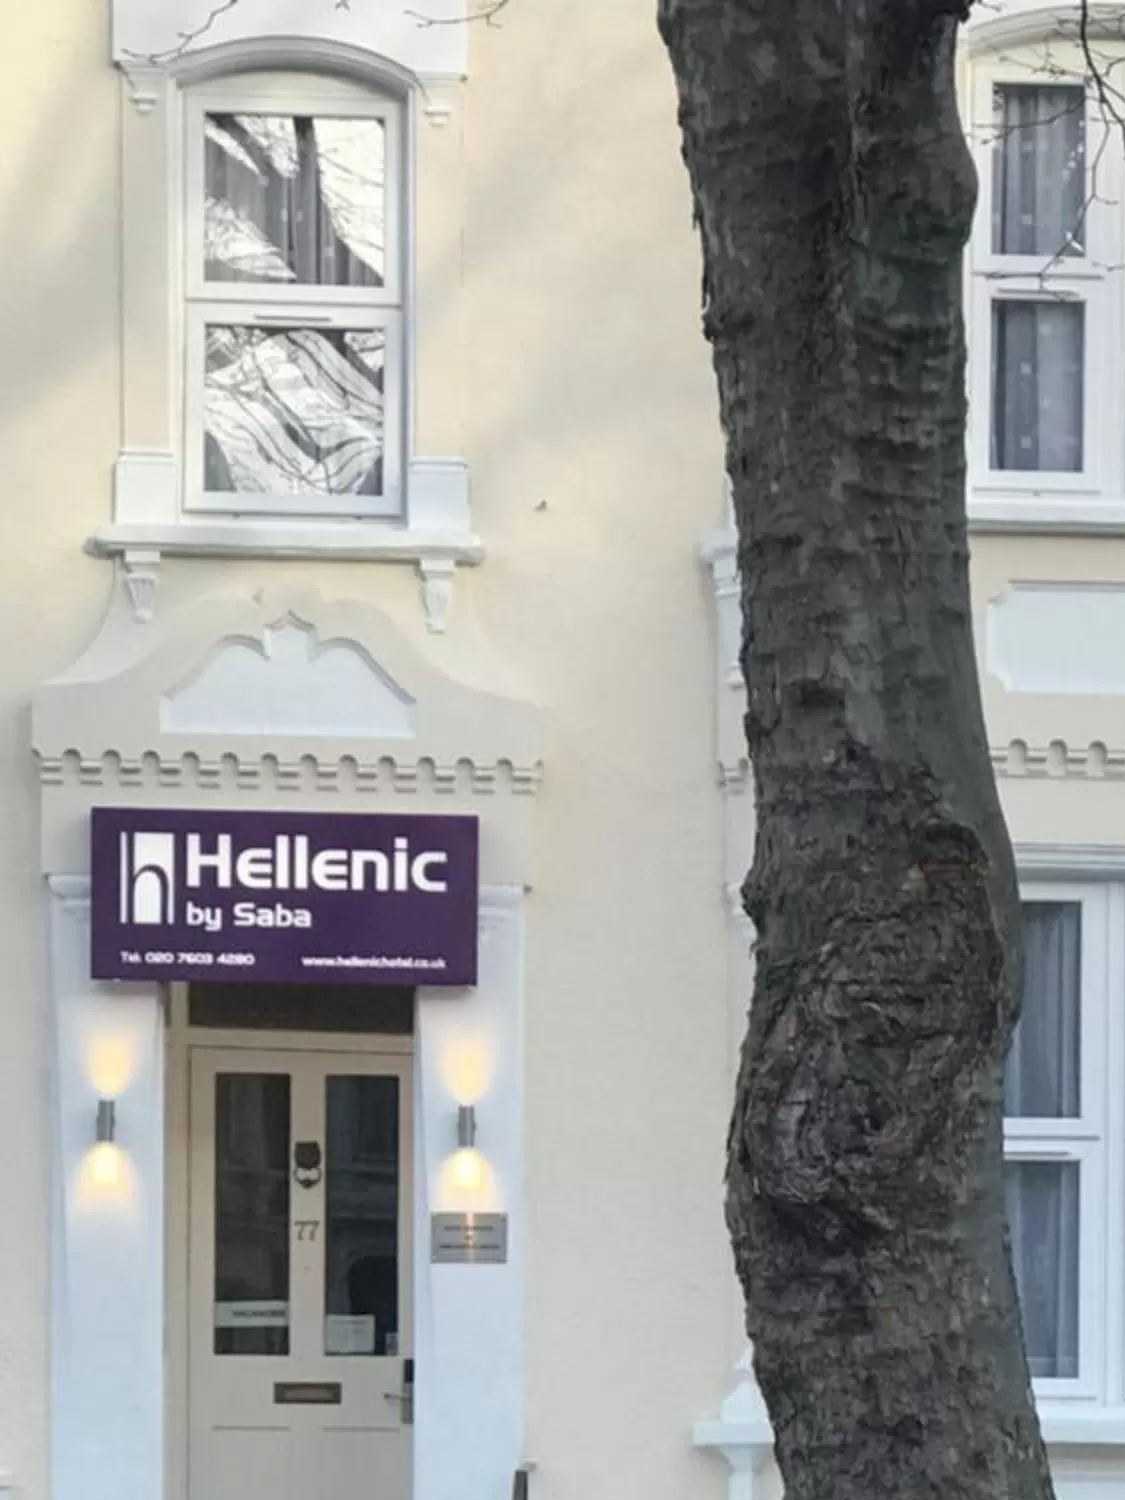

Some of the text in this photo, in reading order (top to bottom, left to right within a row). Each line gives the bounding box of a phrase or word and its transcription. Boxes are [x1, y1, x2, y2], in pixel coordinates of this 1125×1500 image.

[186, 833, 448, 893] Hellenic
[186, 901, 312, 932] by Saba
[144, 950, 175, 965] 020
[294, 1219, 320, 1241] 77
